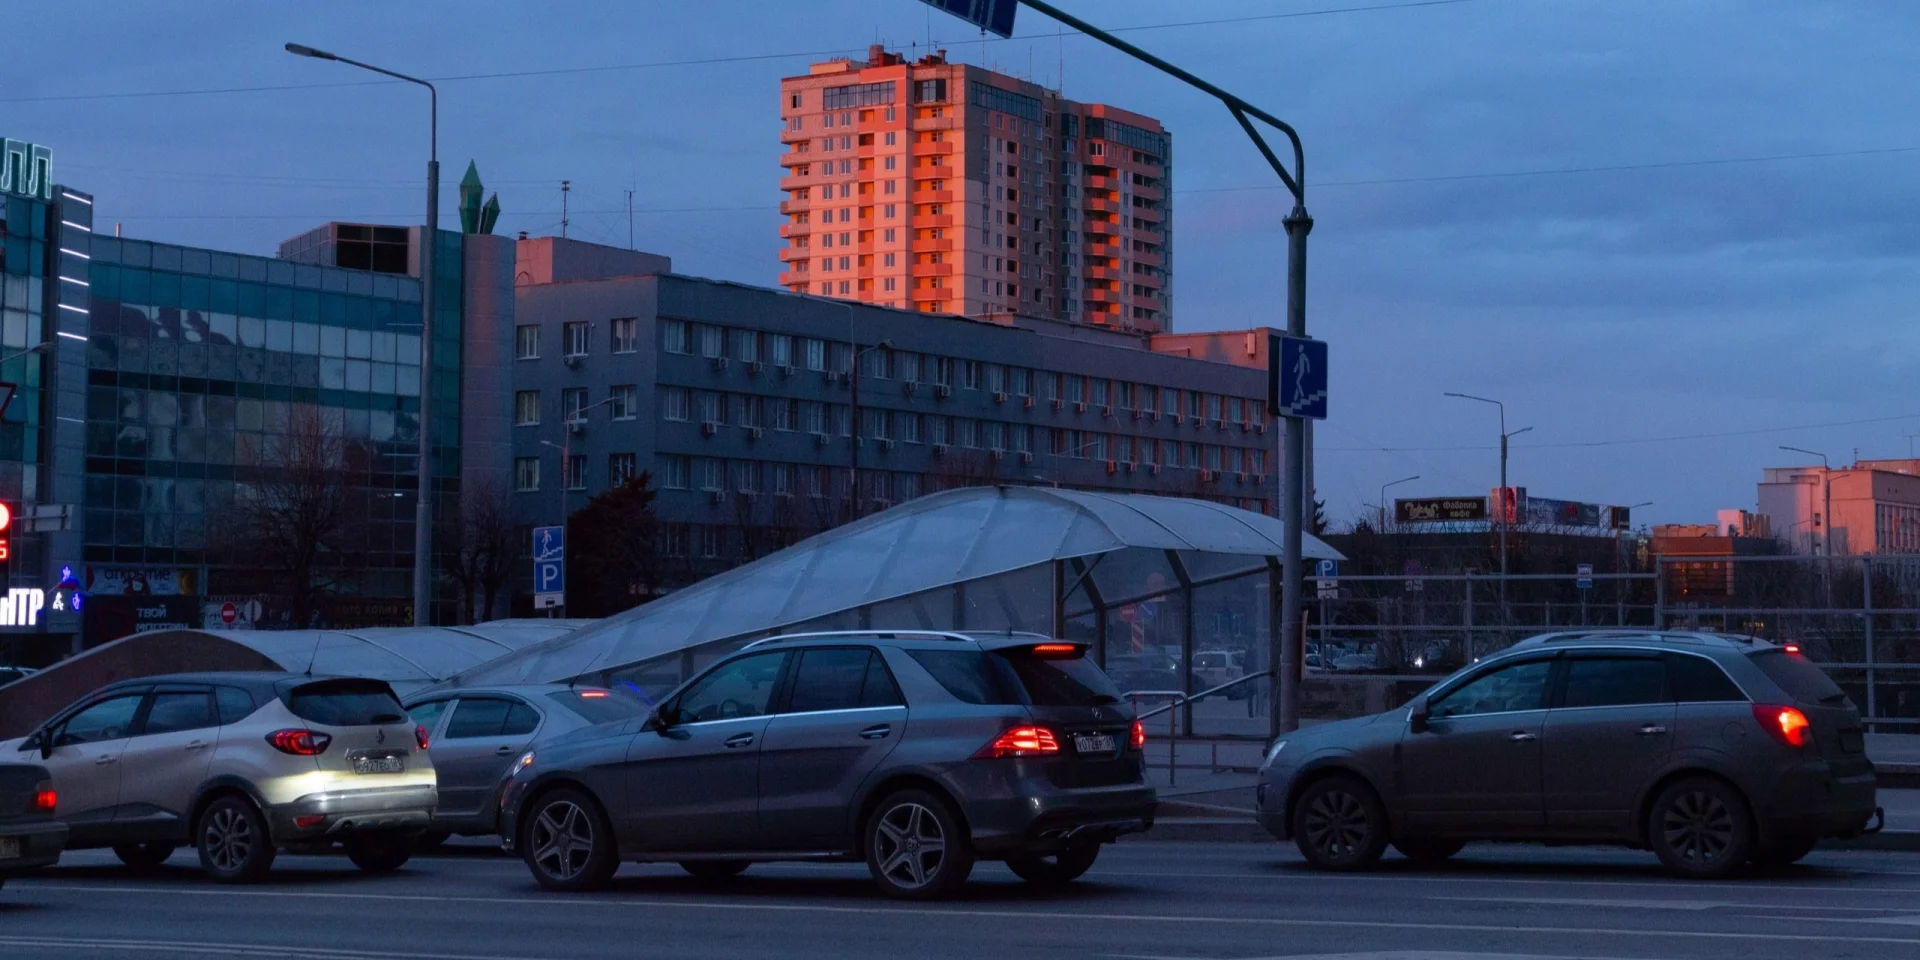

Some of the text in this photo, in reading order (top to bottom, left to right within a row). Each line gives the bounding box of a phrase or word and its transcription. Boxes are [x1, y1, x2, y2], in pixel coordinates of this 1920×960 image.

[1443, 501, 1478, 510] Фабрика
[1322, 560, 1333, 576] P
[542, 564, 558, 590] P
